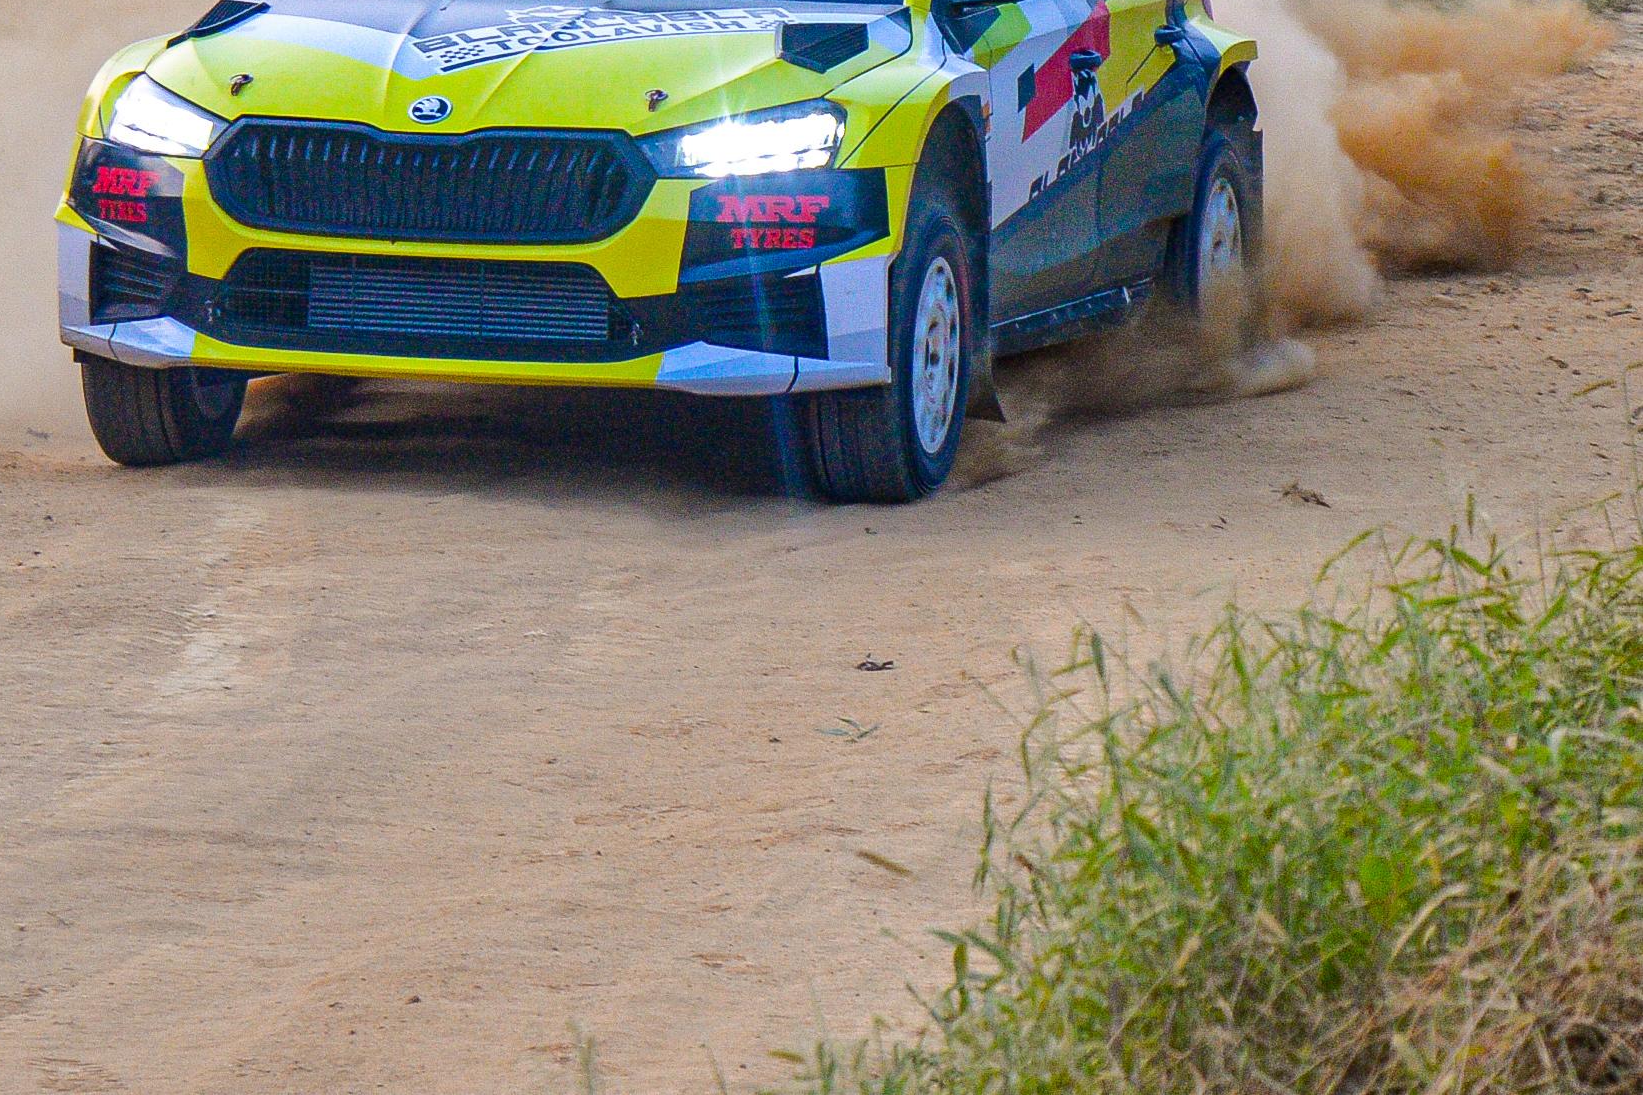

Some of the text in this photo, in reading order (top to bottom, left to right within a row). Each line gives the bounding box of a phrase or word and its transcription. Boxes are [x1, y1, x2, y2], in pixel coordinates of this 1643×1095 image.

[484, 20, 747, 50] TOOLAVISH
[92, 165, 161, 198] MRF
[715, 194, 830, 223] MRF
[730, 227, 816, 249] TYRES
